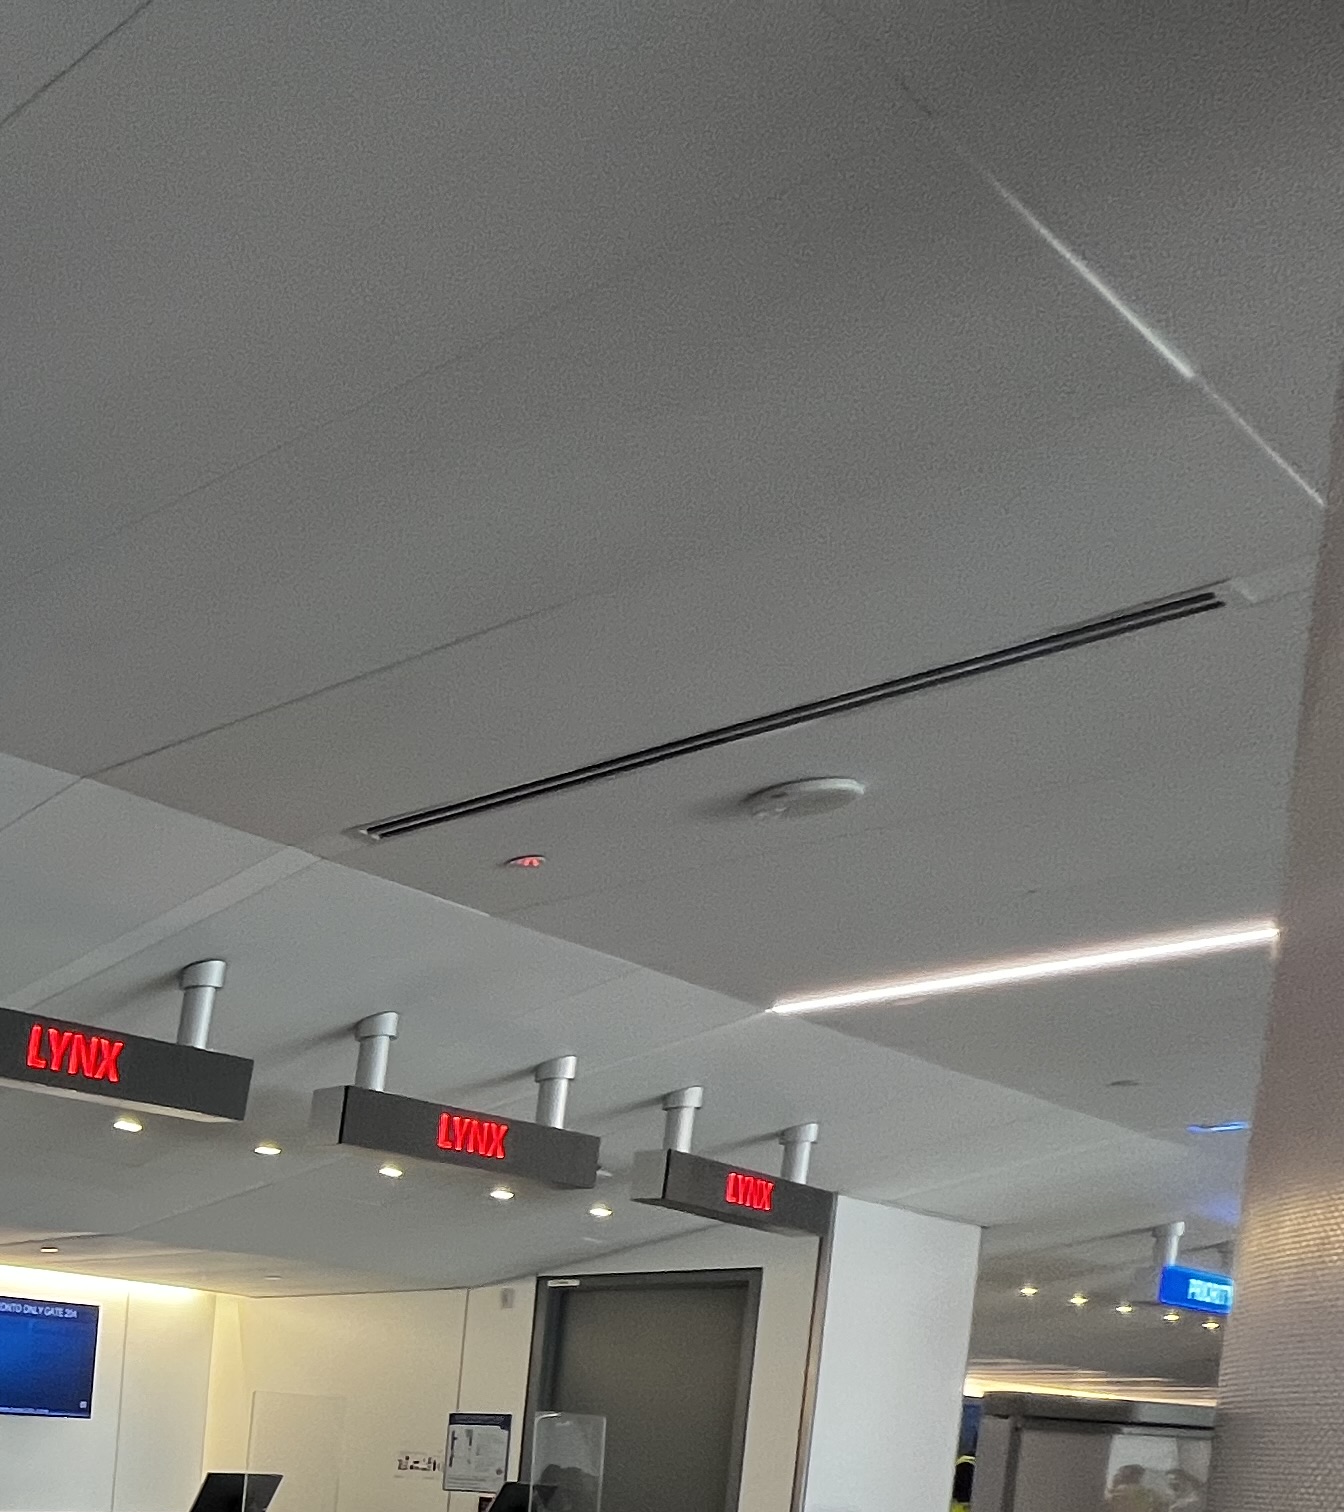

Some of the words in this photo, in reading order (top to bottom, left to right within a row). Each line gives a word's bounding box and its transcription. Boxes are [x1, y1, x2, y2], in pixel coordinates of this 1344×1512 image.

[26, 1024, 124, 1083] LYNX
[437, 1112, 509, 1159] LYNX
[726, 1172, 775, 1212] LYNX
